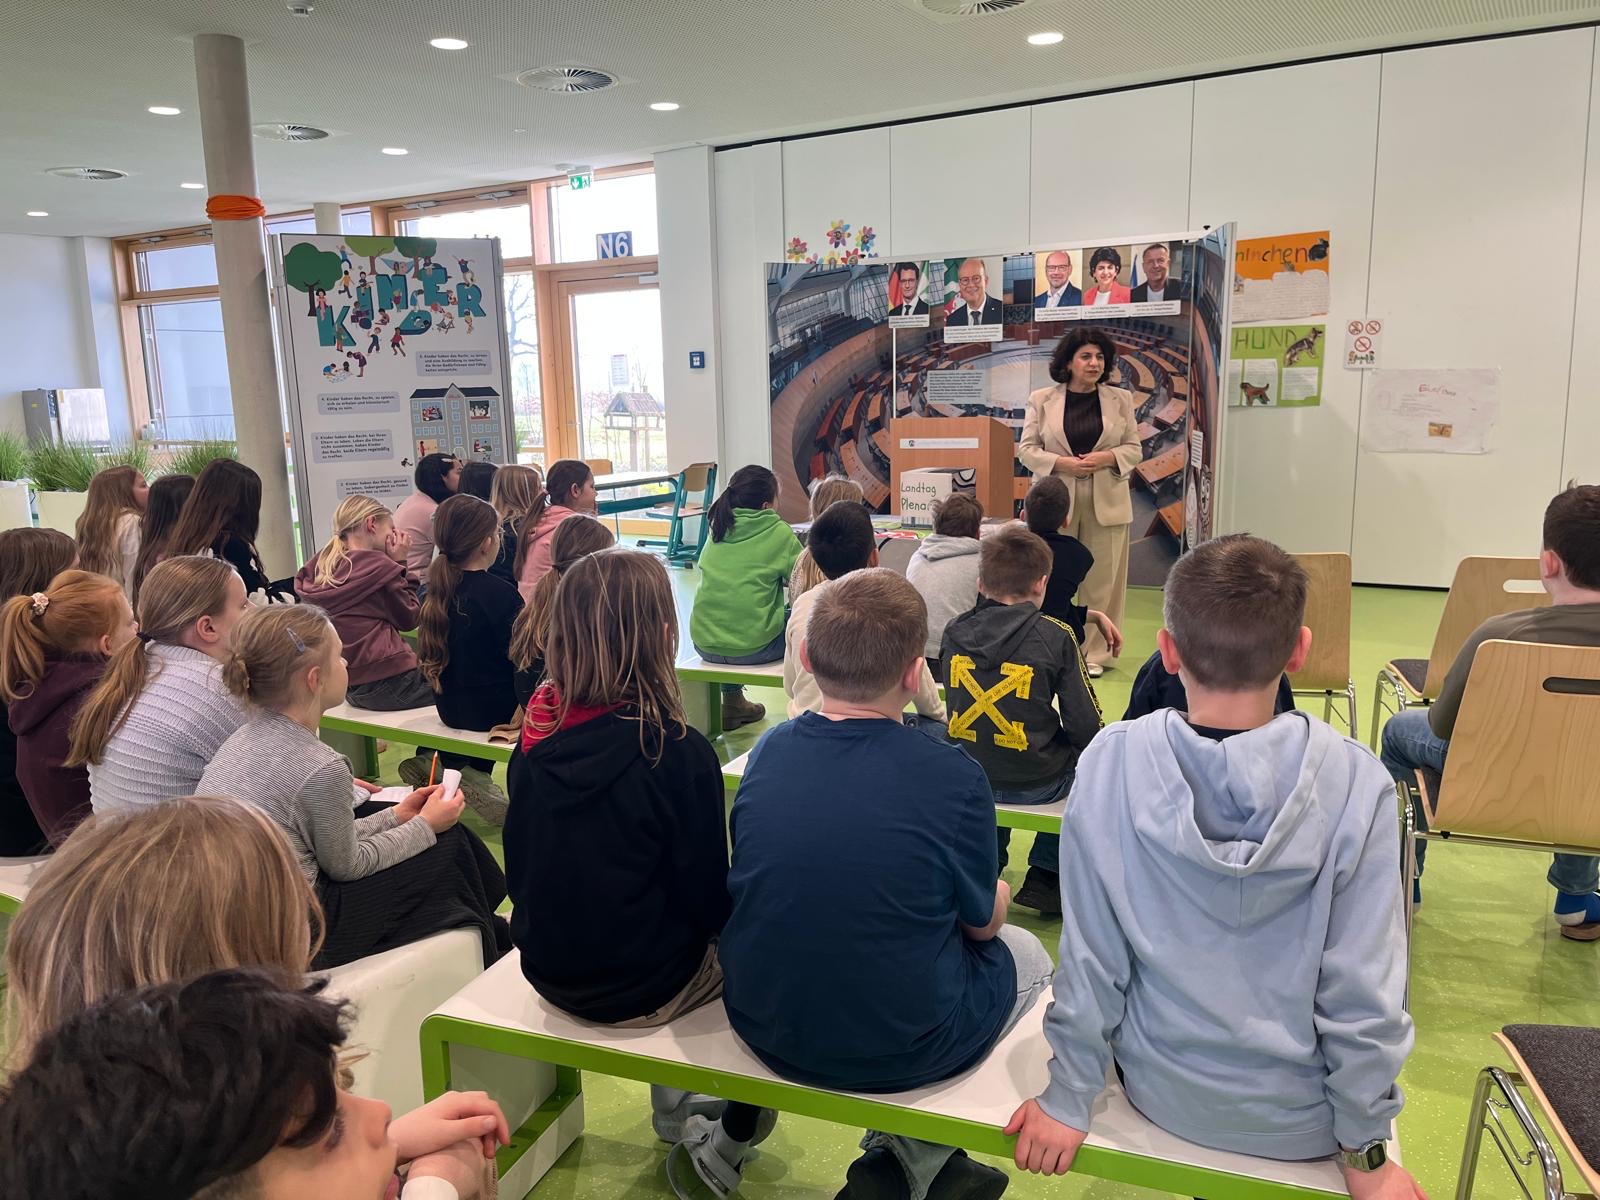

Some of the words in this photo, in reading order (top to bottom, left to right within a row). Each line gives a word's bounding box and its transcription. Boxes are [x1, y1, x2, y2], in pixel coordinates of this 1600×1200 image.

[597, 233, 629, 260] N6
[1236, 244, 1308, 263] ninchen
[316, 264, 486, 347] KINDER
[1235, 328, 1296, 350] HUND
[901, 482, 936, 497] Landtag
